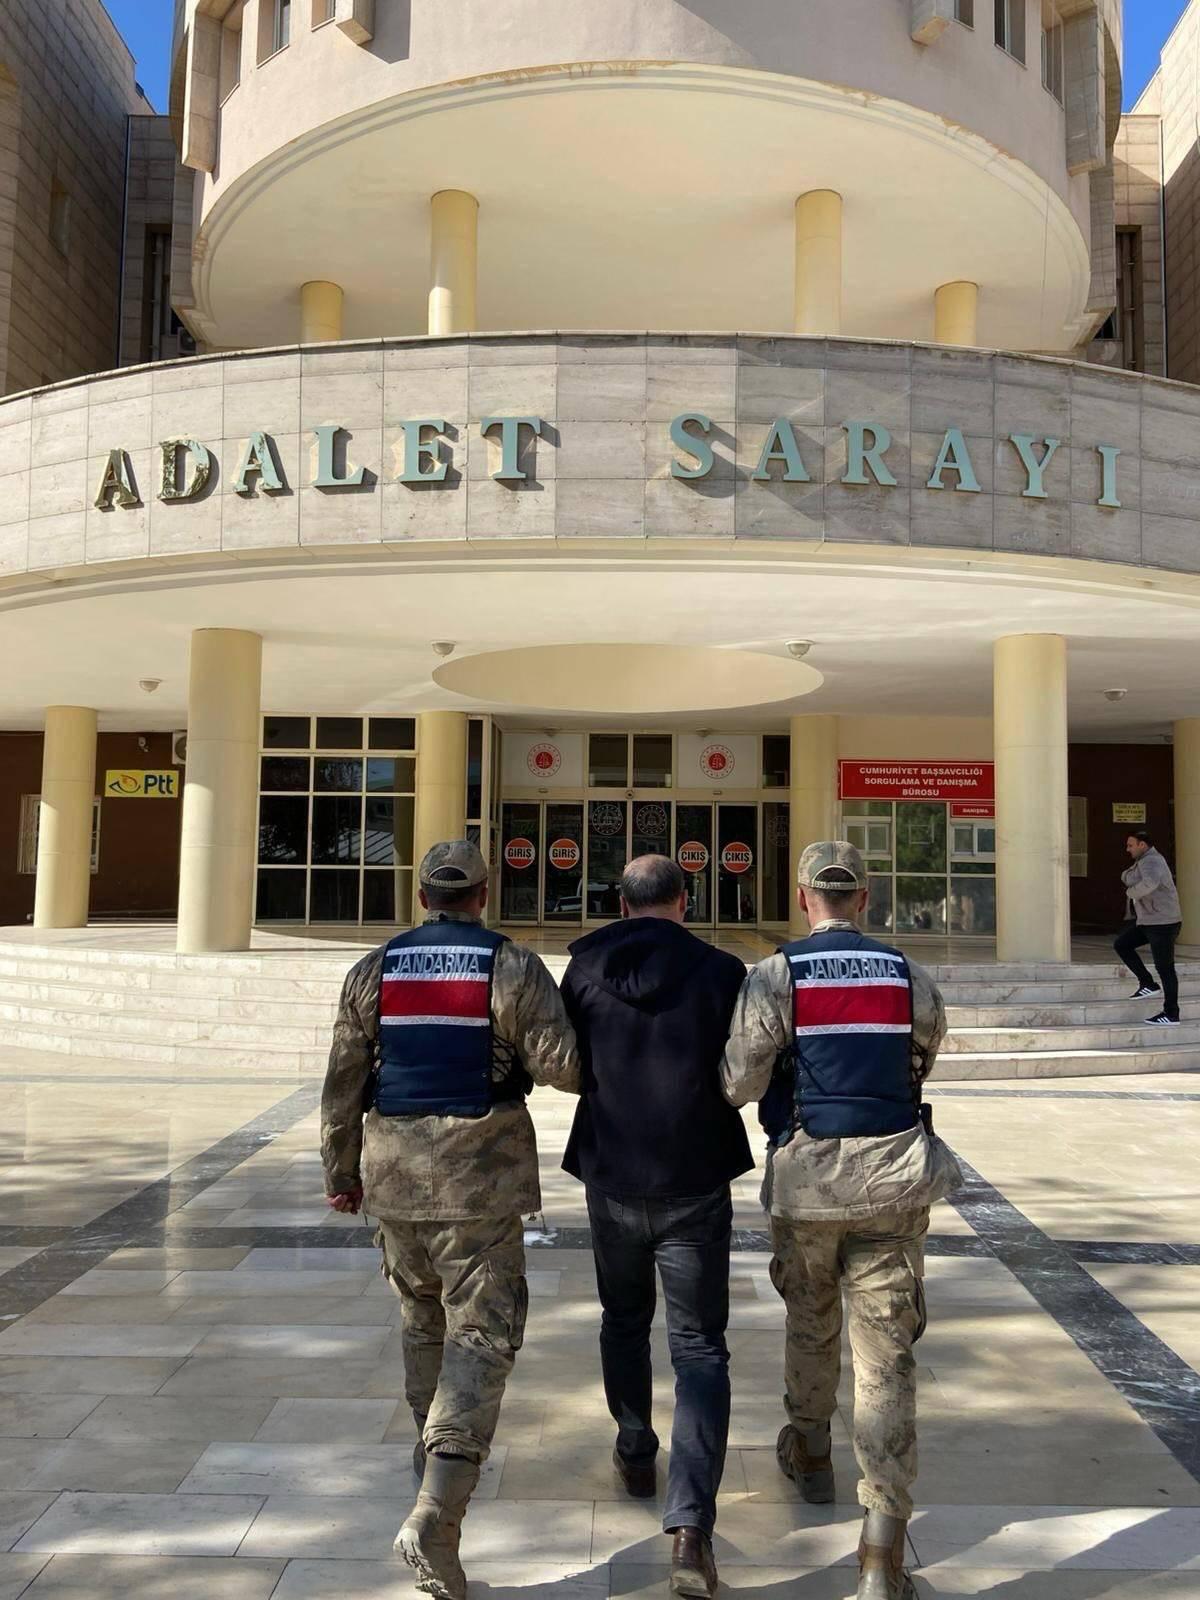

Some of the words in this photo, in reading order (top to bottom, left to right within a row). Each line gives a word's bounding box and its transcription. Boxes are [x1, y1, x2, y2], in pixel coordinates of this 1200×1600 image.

[94, 415, 542, 511] ADALET
[670, 412, 1121, 507] SARAYI
[859, 766, 919, 775] CUMHURİYET
[920, 767, 983, 777] BAŞSAVCILIĞI
[143, 774, 174, 795] Ptt
[864, 777, 920, 785] SORGULAMA
[922, 778, 934, 786] VE
[936, 778, 978, 788] DANIŞMA
[902, 787, 940, 796] BÜROSU
[391, 953, 480, 974] JANDARMA
[805, 958, 900, 979] JANDARMA
